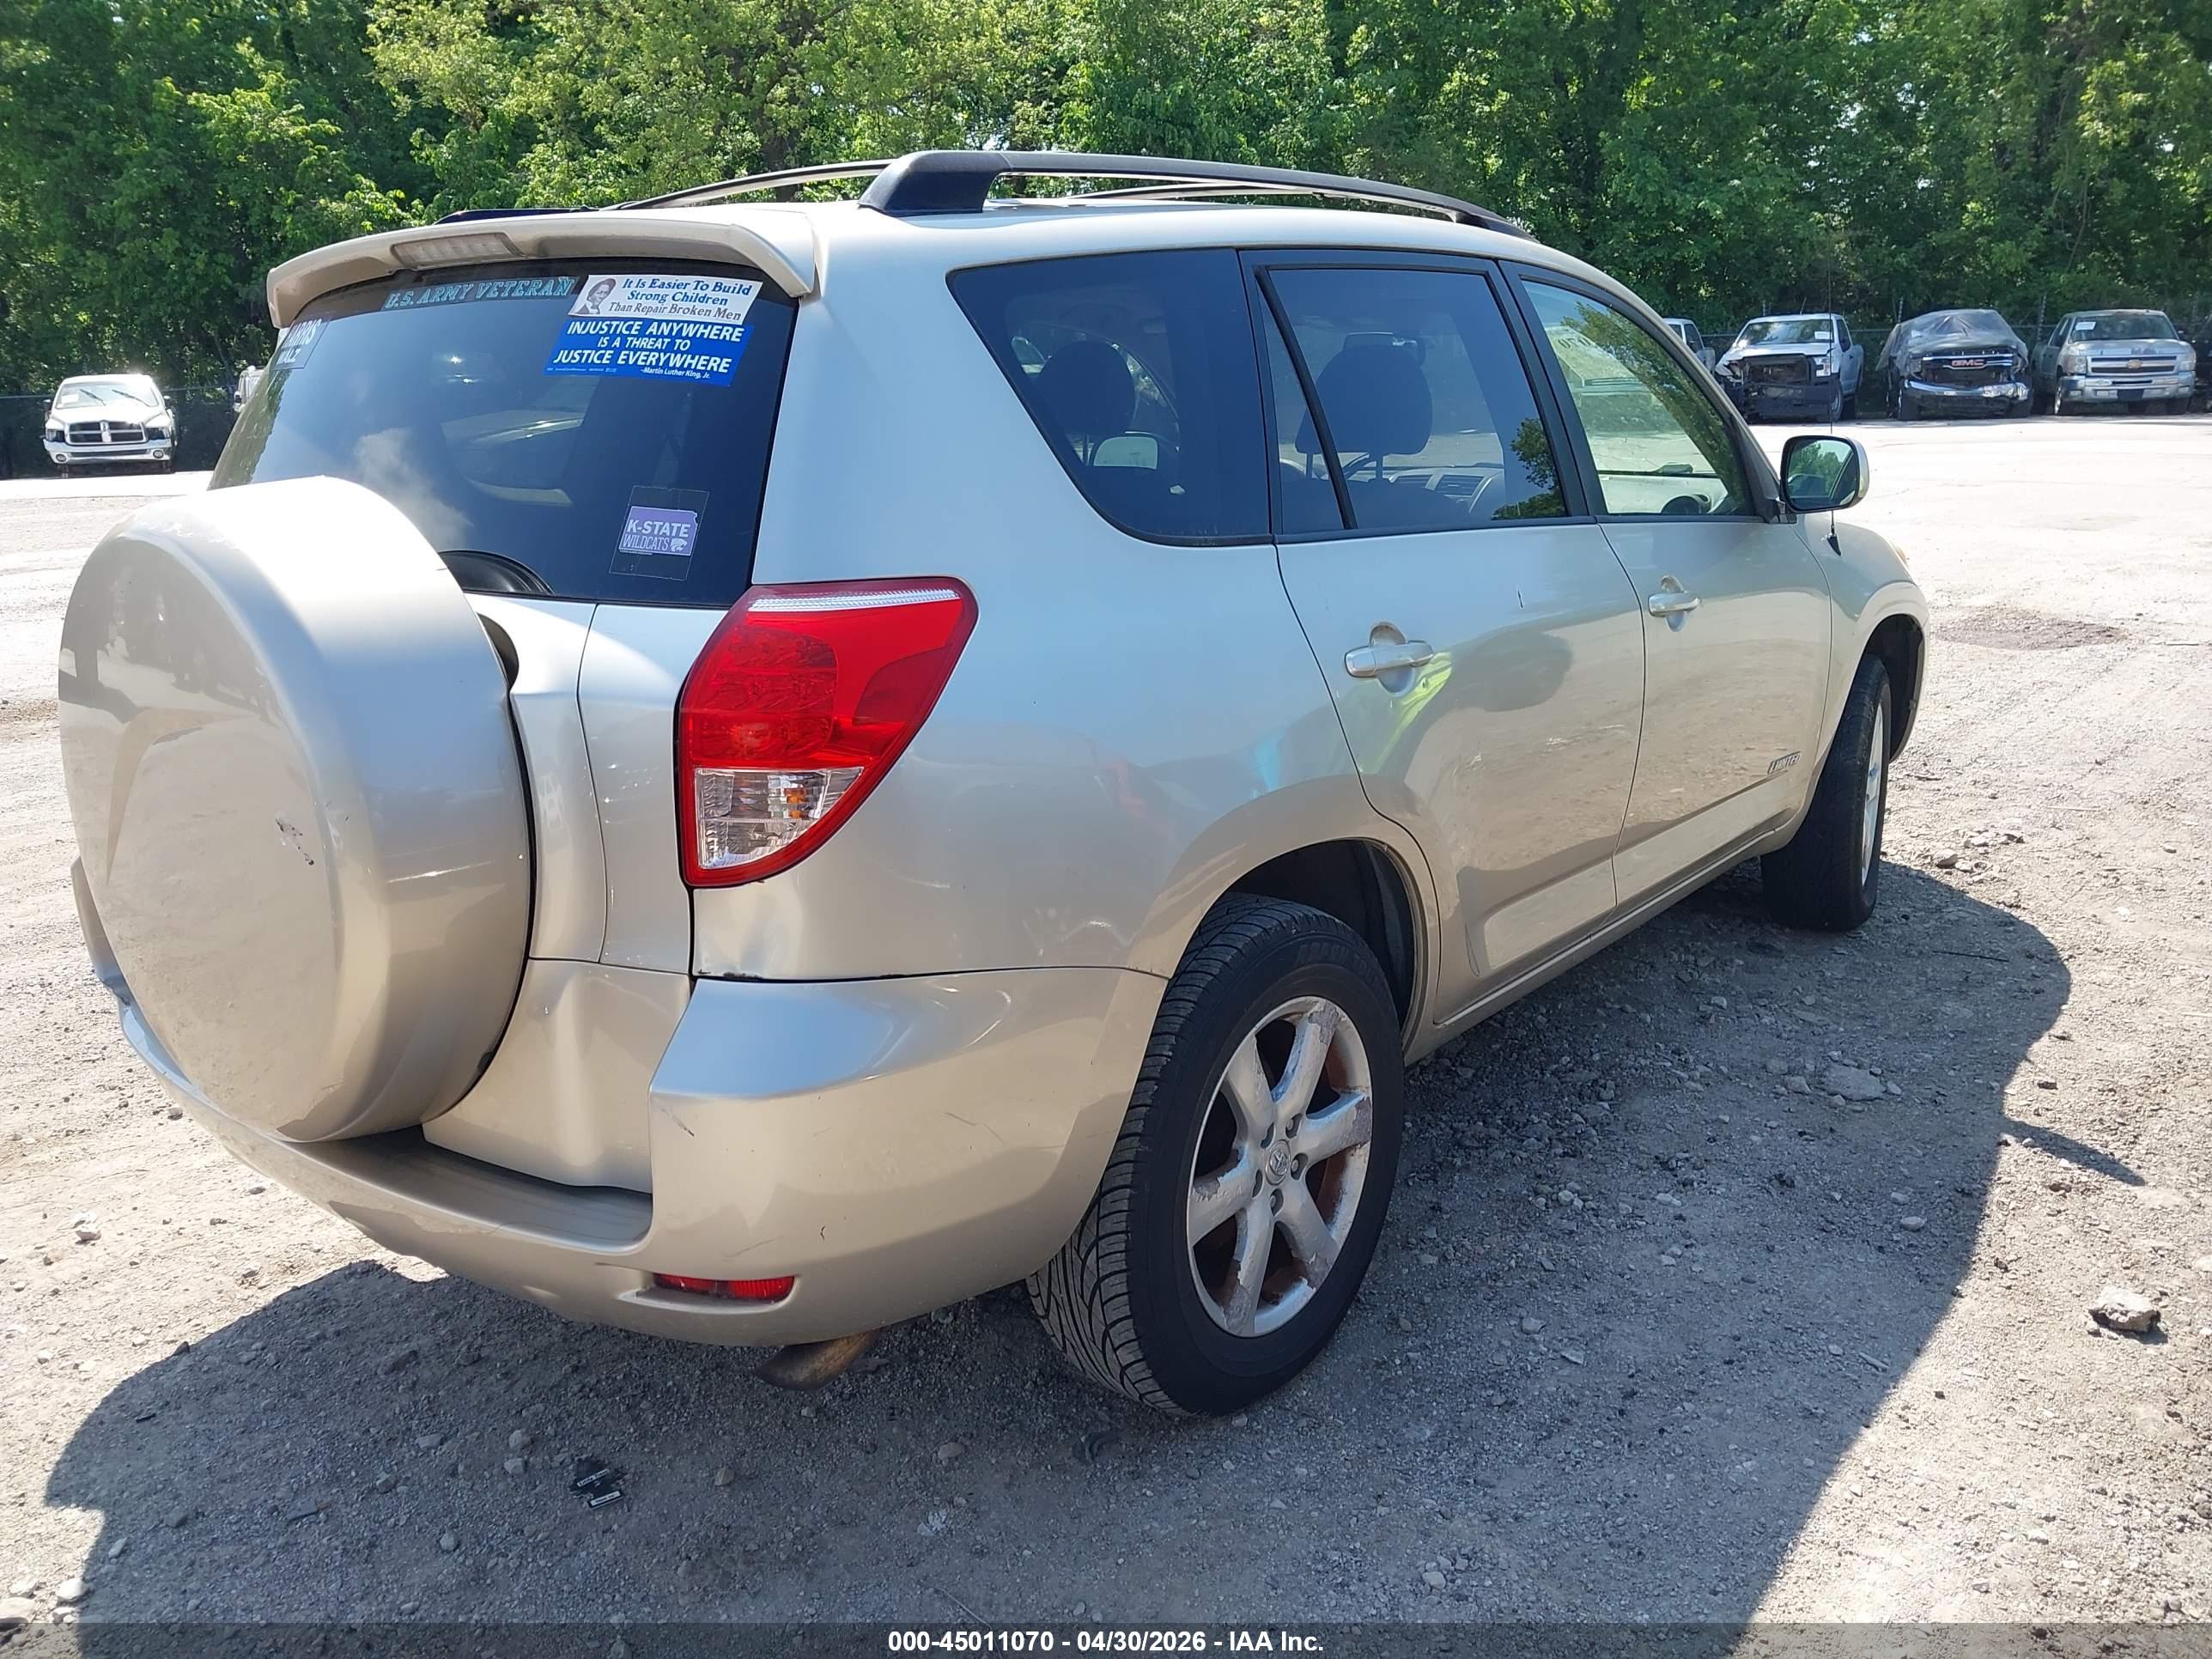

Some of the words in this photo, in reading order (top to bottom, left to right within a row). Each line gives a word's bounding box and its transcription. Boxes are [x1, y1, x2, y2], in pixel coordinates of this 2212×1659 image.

[384, 291, 414, 308] U.S.
[416, 283, 474, 304] ARMY
[476, 276, 575, 299] VETERAN
[622, 278, 634, 289] It
[635, 279, 647, 289] Is
[648, 279, 691, 290] Easier
[693, 280, 709, 291] To
[711, 282, 752, 295] Build
[627, 291, 670, 304] Strong
[672, 292, 729, 306] Children
[608, 301, 632, 313] Than
[633, 303, 668, 315] Repair
[668, 304, 713, 318] Broken
[712, 307, 742, 321] Men
[567, 320, 643, 335] INJUSTICE
[646, 322, 744, 342] ANYWHERE
[597, 337, 609, 348] IS
[611, 337, 620, 348] A
[624, 337, 671, 350] THREAT
[673, 339, 691, 351] TO
[553, 349, 614, 364] JUSTICE
[617, 351, 732, 373] EVERYWHERE
[664, 368, 686, 377] Luther
[627, 520, 690, 538] K-STATE
[623, 533, 670, 551] WILDCATS
